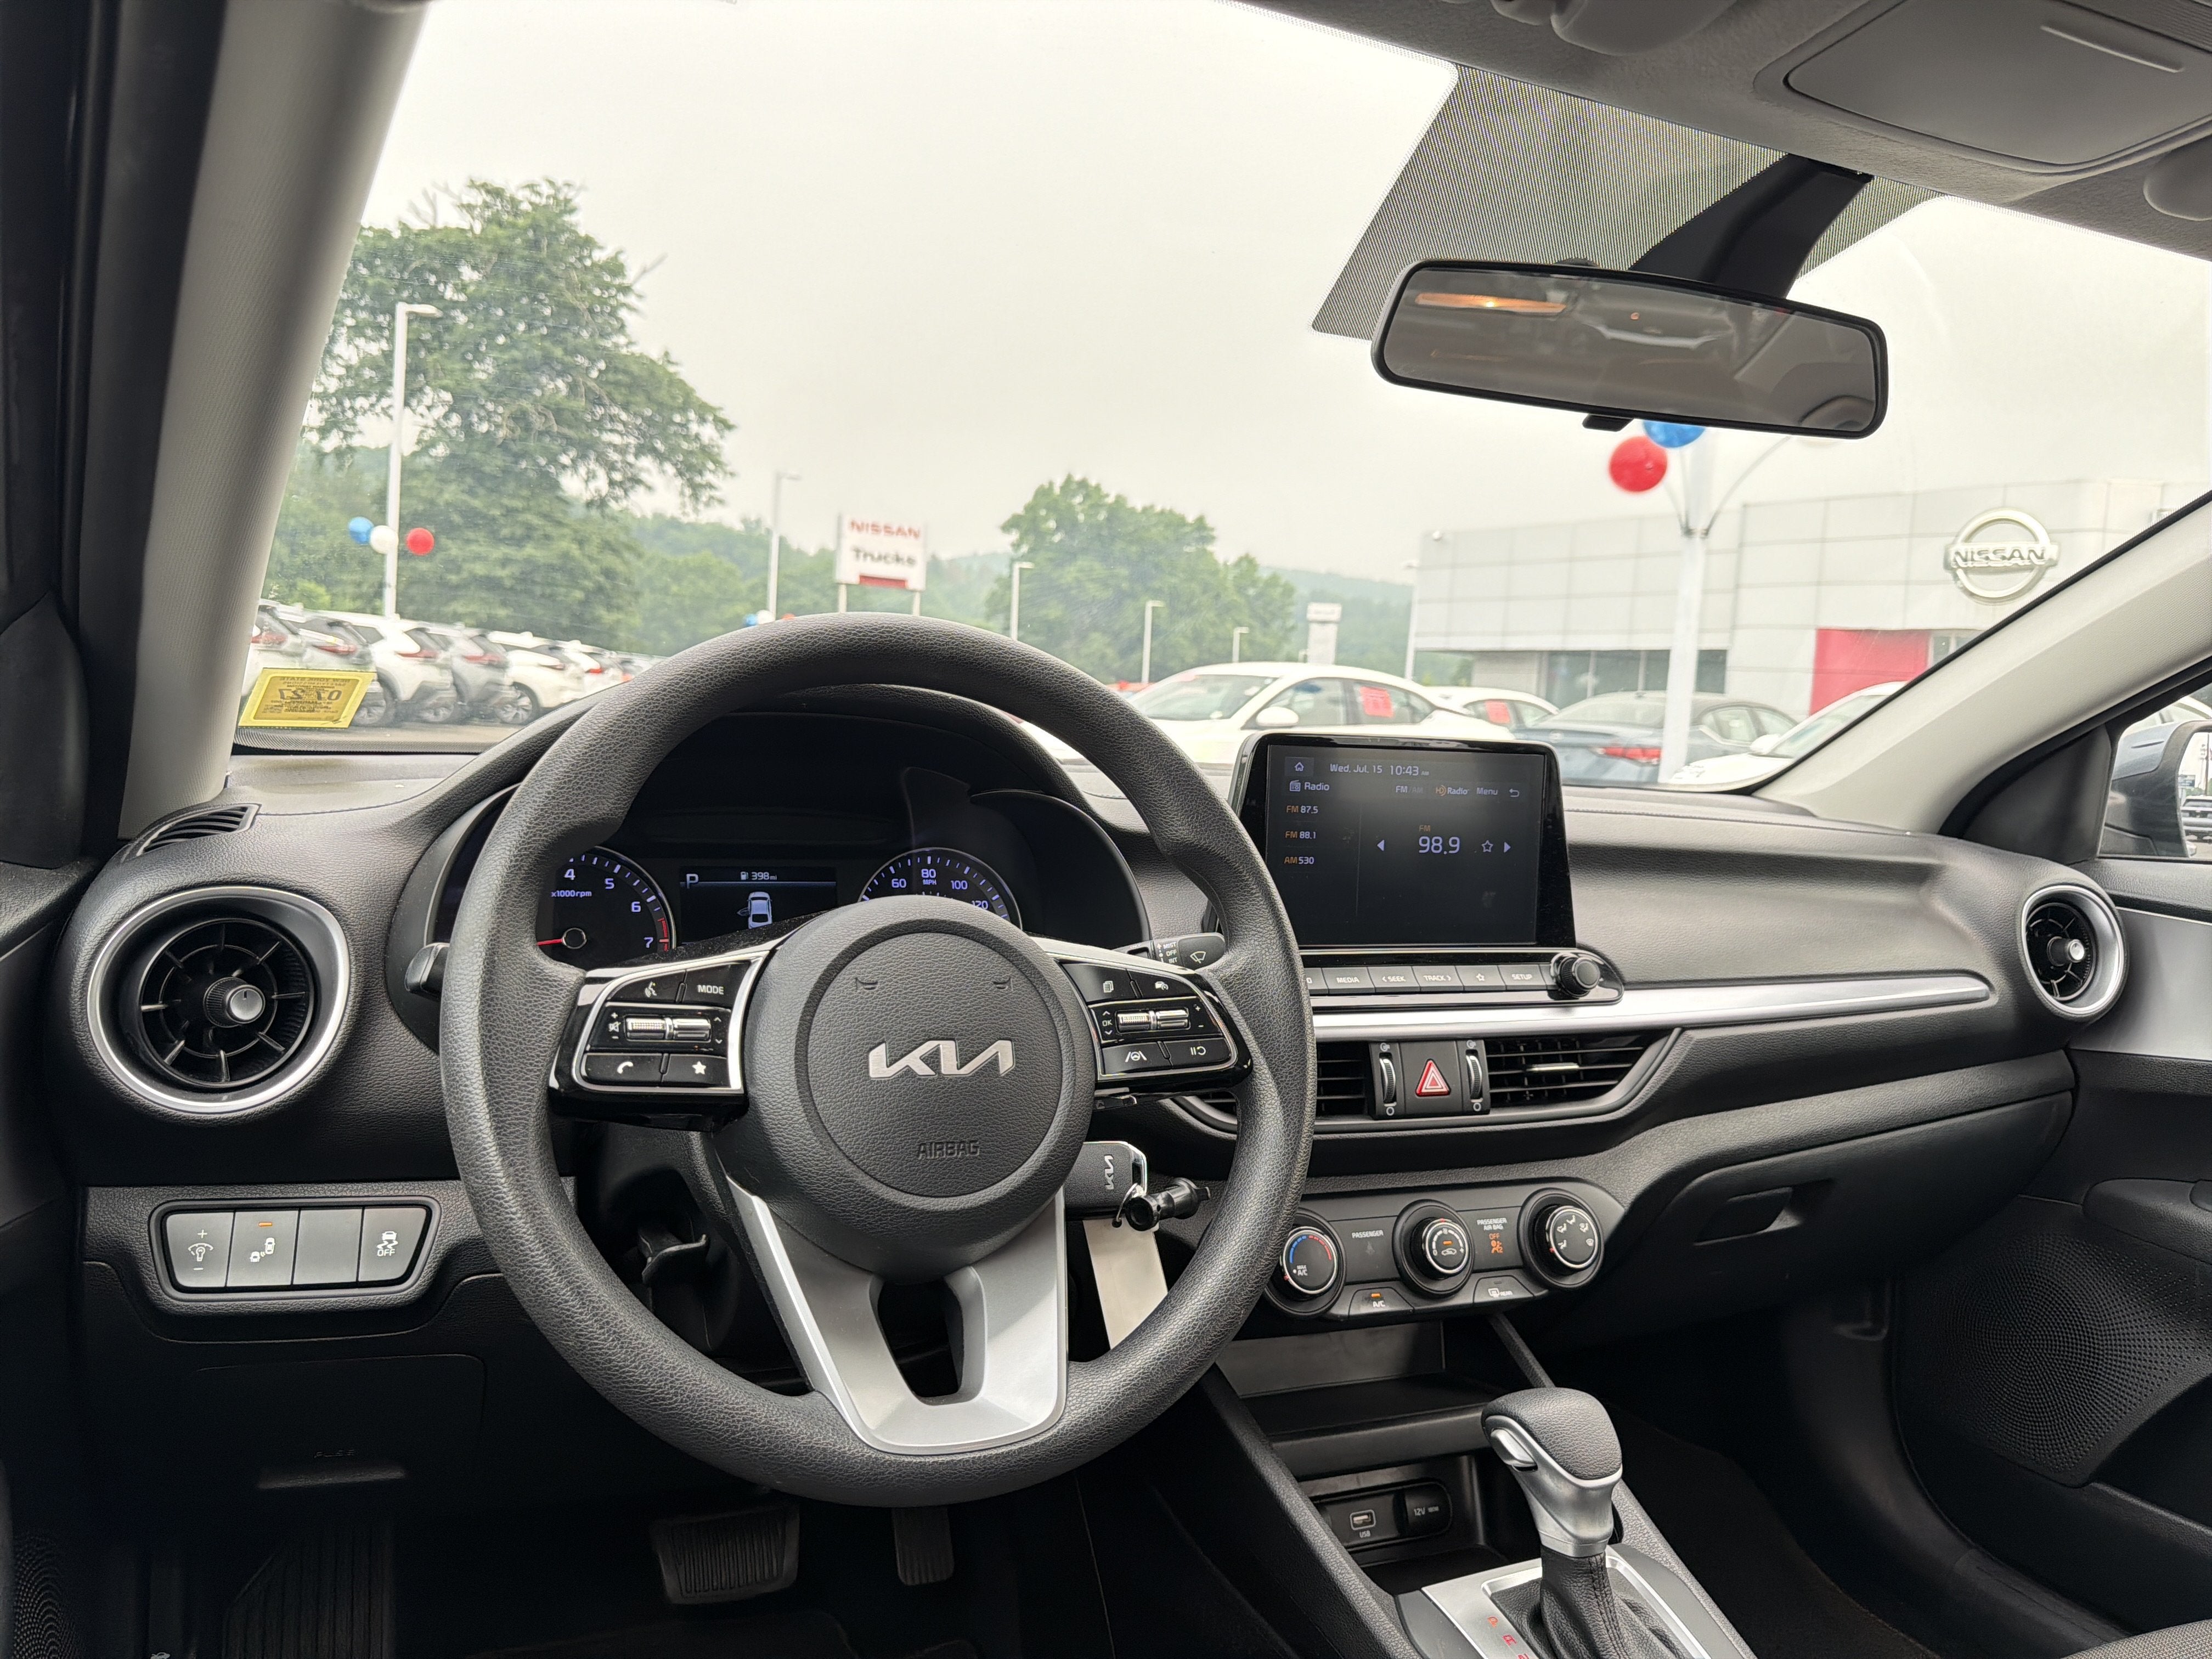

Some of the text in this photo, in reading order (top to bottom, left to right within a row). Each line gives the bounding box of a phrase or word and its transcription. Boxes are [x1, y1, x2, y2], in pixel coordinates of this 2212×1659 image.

[851, 520, 920, 539] NISSAN
[854, 546, 917, 566] Trucks
[1952, 546, 2046, 566] NISSAN
[1390, 765, 1419, 776] 10:43
[1305, 782, 1330, 791] Radio
[1301, 805, 1318, 814] 87.5
[1299, 831, 1316, 839] 88.1
[1419, 836, 1460, 855] 98.9
[564, 868, 575, 880] 4
[921, 868, 936, 878] 80
[605, 878, 615, 889] 5
[686, 873, 699, 889] P
[891, 878, 906, 888] 60
[950, 880, 968, 890] 100
[631, 901, 641, 912] 6
[644, 936, 653, 948] 7
[697, 984, 724, 995] MODE
[869, 1040, 1014, 1078] KIA
[918, 1140, 980, 1159] AIRBAG
[1352, 1230, 1384, 1239] PASSENGER
[377, 1249, 395, 1257] OFF
[1413, 1507, 1425, 1516] 12V
[1359, 1530, 1370, 1538] USB
